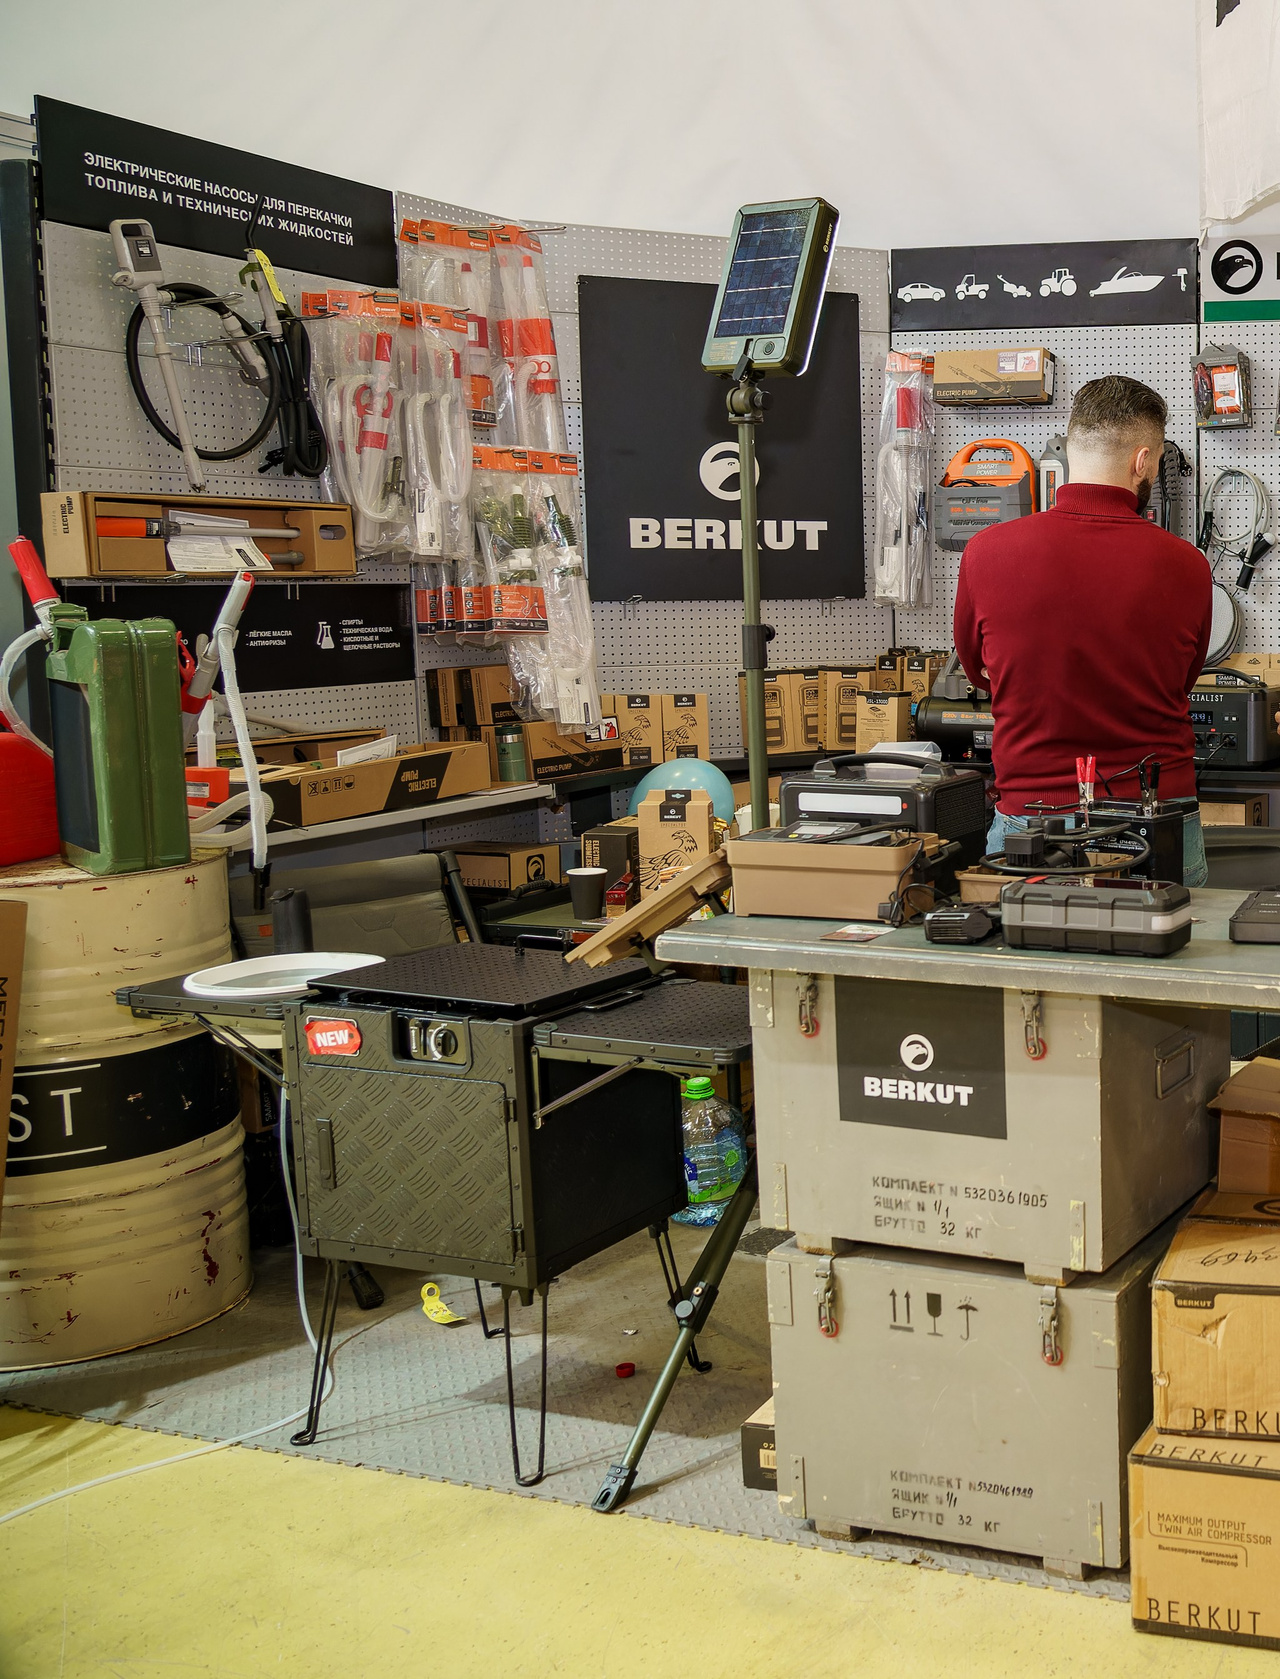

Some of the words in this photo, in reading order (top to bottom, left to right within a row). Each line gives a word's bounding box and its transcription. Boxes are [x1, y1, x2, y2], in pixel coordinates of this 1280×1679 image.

[84, 151, 202, 192] ЭЛЕКТРИЧЕСКИЕ
[262, 196, 286, 213] ДЛЯ
[287, 202, 352, 228] ПЕРЕКАЧКИ
[84, 173, 158, 202] ТОПЛИВА
[162, 191, 173, 205] И
[176, 194, 275, 229] ТЕХНИЧЕСИХ
[277, 217, 354, 247] ЖИДКОСТЕЙ
[62, 503, 70, 534] ELECTRIC
[249, 630, 271, 638] ЛЁГКИЕ
[342, 626, 377, 634] ТЕХНИЧЕСКАЯ
[343, 635, 373, 643] КИСЛОТНЫЕ
[249, 639, 286, 647] АНТИФРИЗЫ
[373, 642, 400, 650] РАСТВОРЫ
[401, 770, 418, 782] PUMP
[537, 765, 559, 774] ELECTRIC
[559, 763, 572, 771] PUMP
[408, 778, 436, 792] ELECTRIC
[315, 1029, 349, 1048] NEW
[863, 1076, 973, 1106] BERKUT
[872, 1176, 945, 1196] КОМПЛЕКТ
[964, 1187, 1049, 1208] 5320361905
[873, 1196, 912, 1213] ЯЩИК
[933, 1200, 950, 1218] 1/1
[874, 1214, 926, 1232] БРУТТО
[939, 1221, 956, 1236] 32
[965, 1225, 984, 1240] КГ
[1177, 1299, 1212, 1309] BERKUT
[1150, 1443, 1267, 1468] BERKUT
[890, 1470, 962, 1490] КОМПЛЕКТ
[892, 1488, 928, 1505] ЯЩИК
[892, 1507, 944, 1526] БРУТТО
[958, 1514, 972, 1526] 32
[984, 1521, 1000, 1532] КГ
[1157, 1513, 1203, 1525] MAXIMUM
[1208, 1519, 1246, 1531] OUTPUT
[1158, 1523, 1182, 1534] TWIN
[1187, 1527, 1203, 1537] AIR
[1207, 1529, 1272, 1545] COMPRESSOR
[1201, 1557, 1238, 1567] Компрессор
[1147, 1598, 1261, 1635] BERKUT
